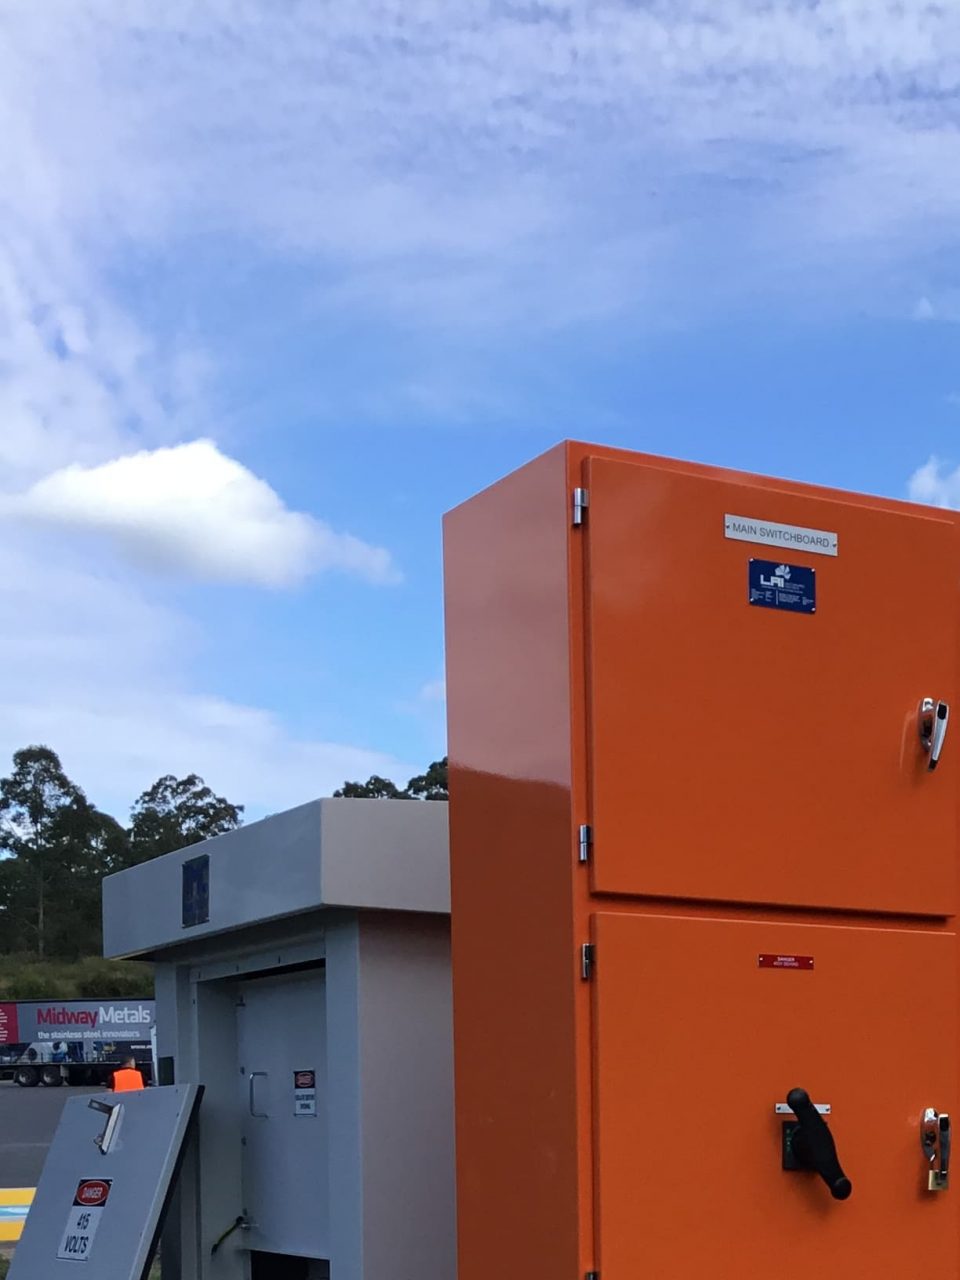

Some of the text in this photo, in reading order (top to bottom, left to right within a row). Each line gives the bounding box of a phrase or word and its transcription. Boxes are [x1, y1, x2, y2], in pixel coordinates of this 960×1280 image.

[732, 522, 830, 548] MAIN SWITCHBOARD
[760, 574, 784, 588] LAI
[37, 1005, 151, 1028] Midway Metals
[38, 1030, 140, 1039] the stainless steel innovators
[76, 1213, 91, 1230] 415
[64, 1235, 89, 1254] VOLTS
